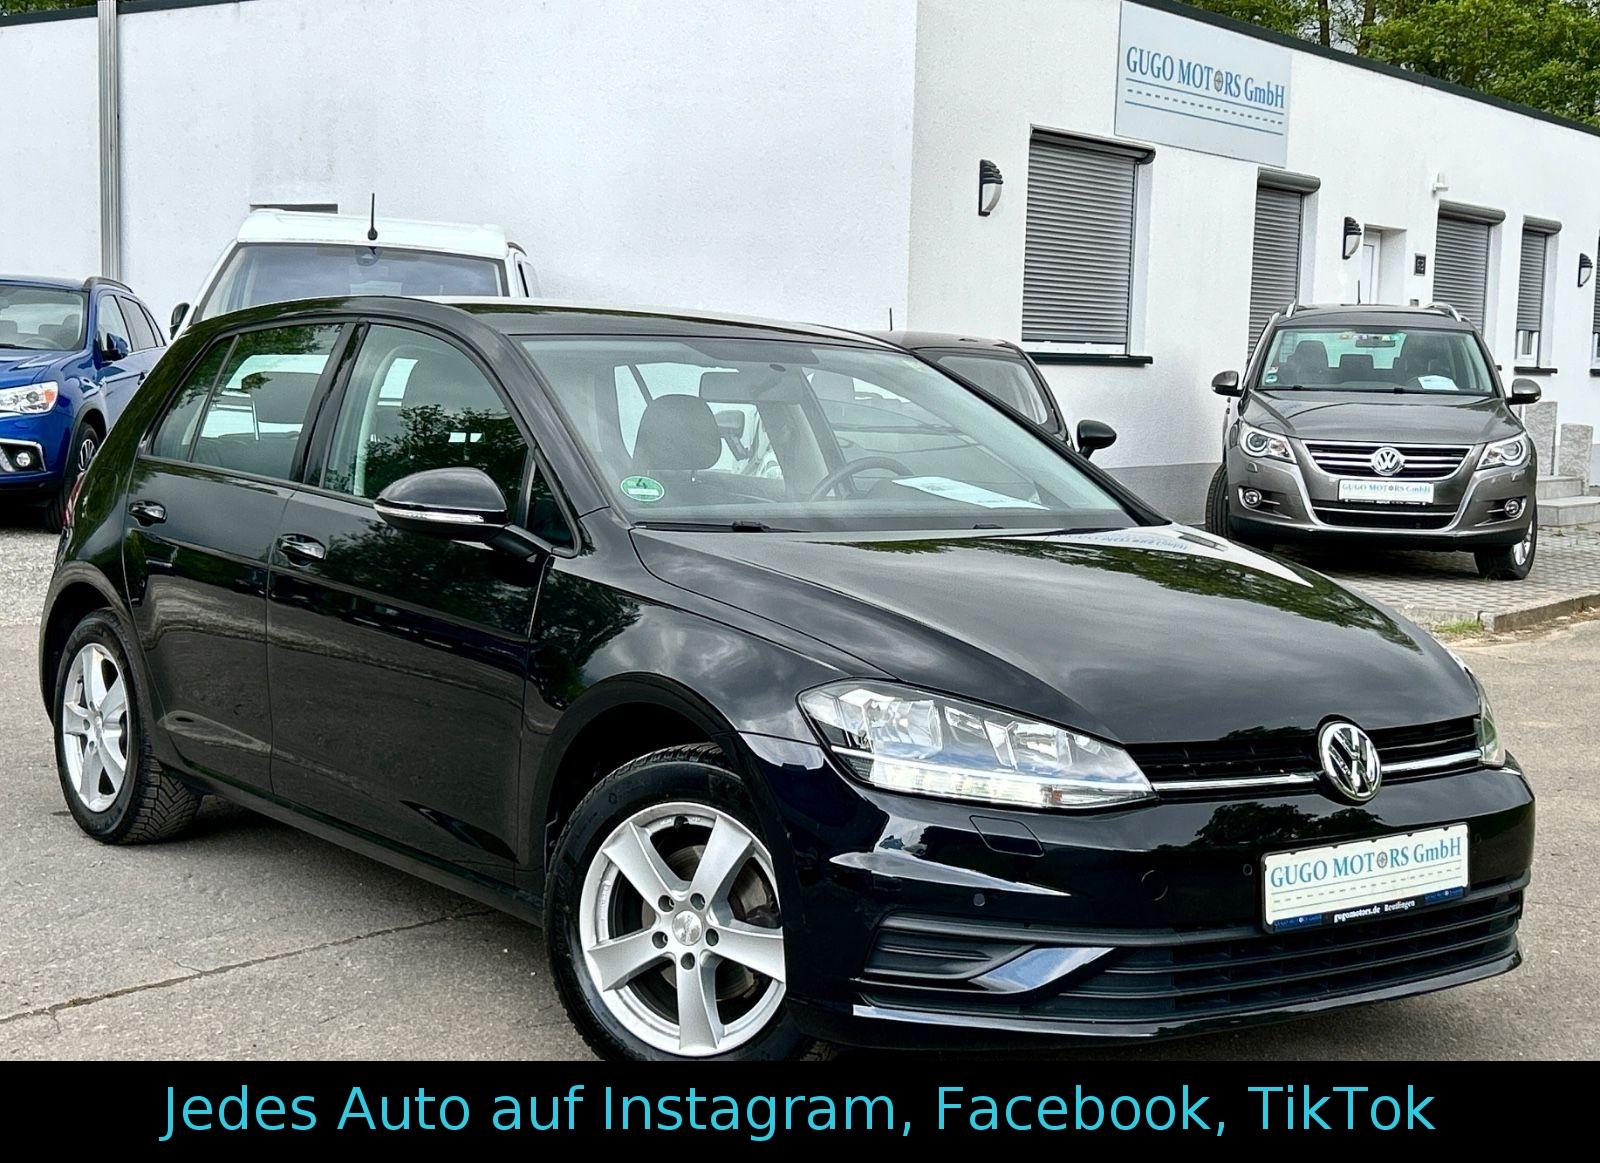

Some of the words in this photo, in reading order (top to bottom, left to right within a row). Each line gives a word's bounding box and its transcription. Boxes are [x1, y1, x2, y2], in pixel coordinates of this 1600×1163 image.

[1126, 46, 1174, 81] GUGO
[1177, 58, 1242, 98] MOTORS
[1244, 77, 1285, 109] GmbH
[1342, 483, 1367, 491] GUGO
[1270, 860, 1328, 888] GUGO
[1332, 846, 1410, 879] MOTORS
[1413, 836, 1462, 864] GmbH
[1333, 905, 1381, 923] gugomotors.de
